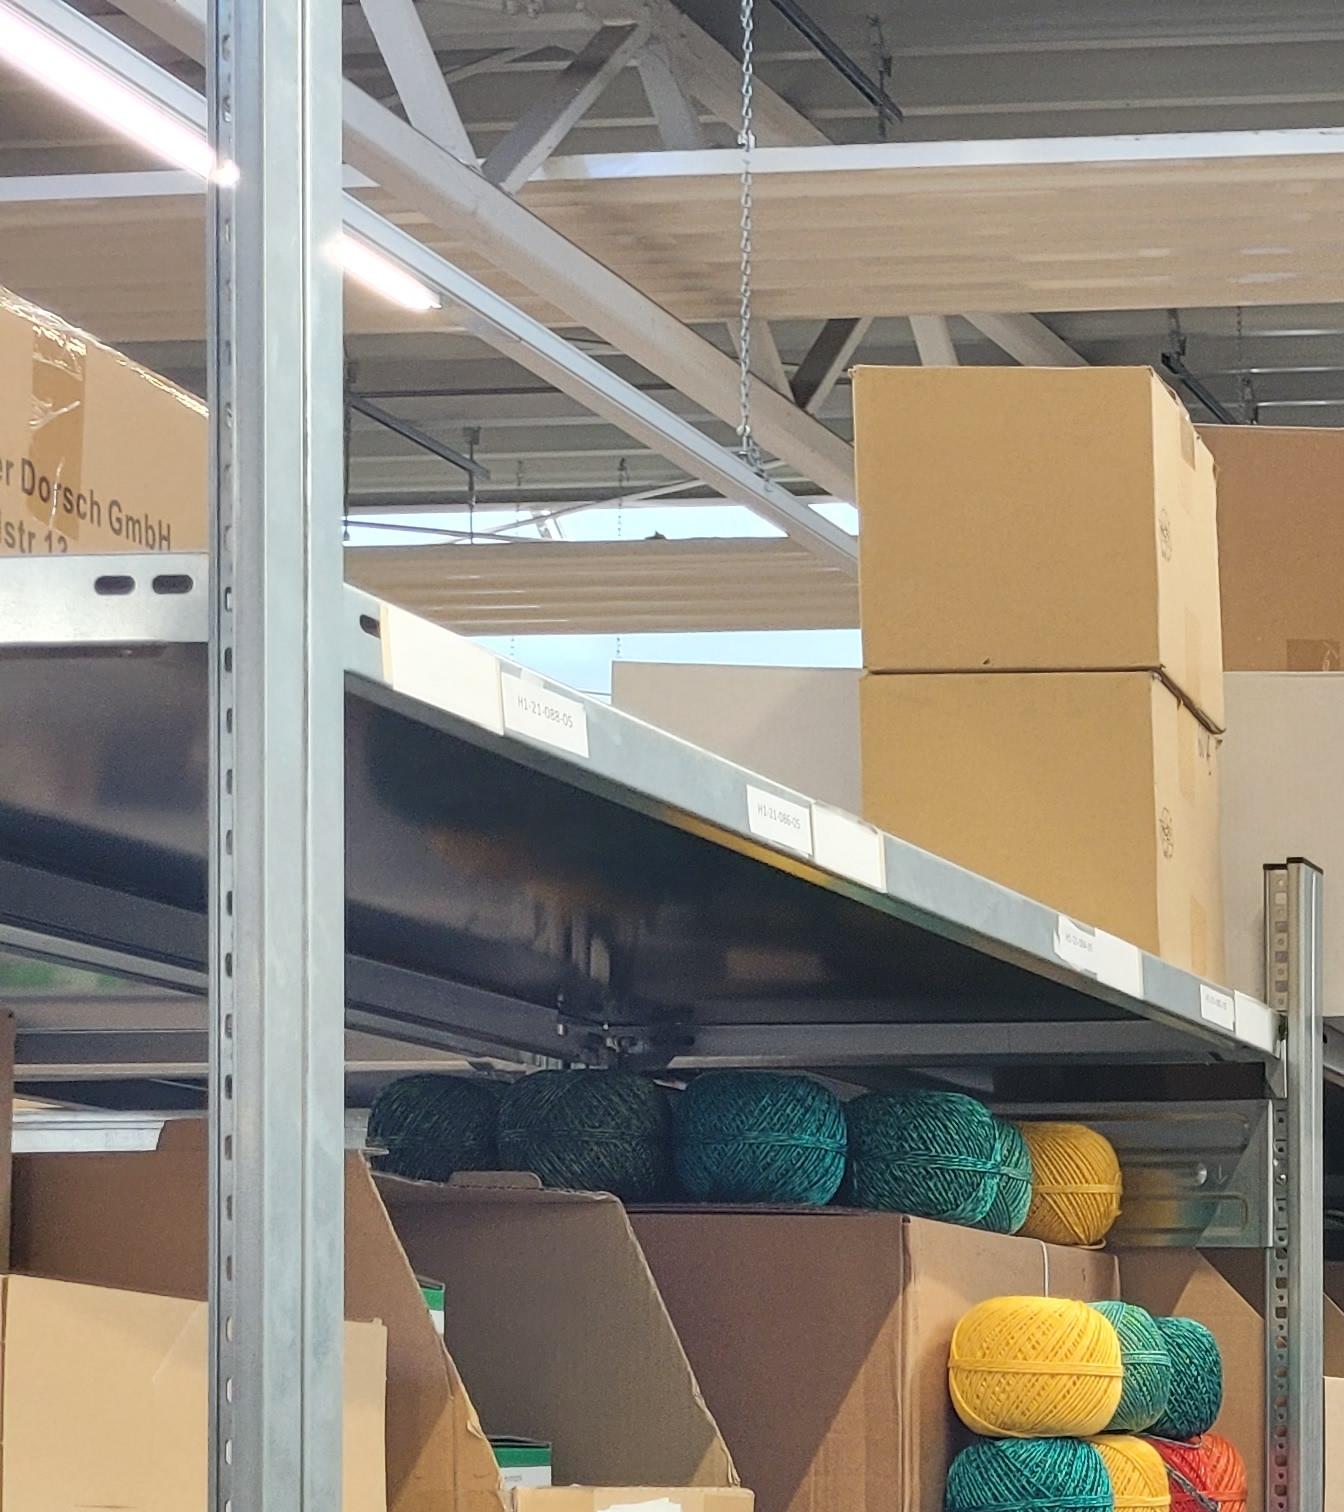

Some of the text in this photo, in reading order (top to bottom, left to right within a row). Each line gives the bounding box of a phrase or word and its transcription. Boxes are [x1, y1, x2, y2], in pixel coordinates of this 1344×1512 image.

[0, 457, 172, 552] r Dorsch GmbH
[0, 508, 37, 554] str
[516, 695, 574, 729] H1-21-088-05
